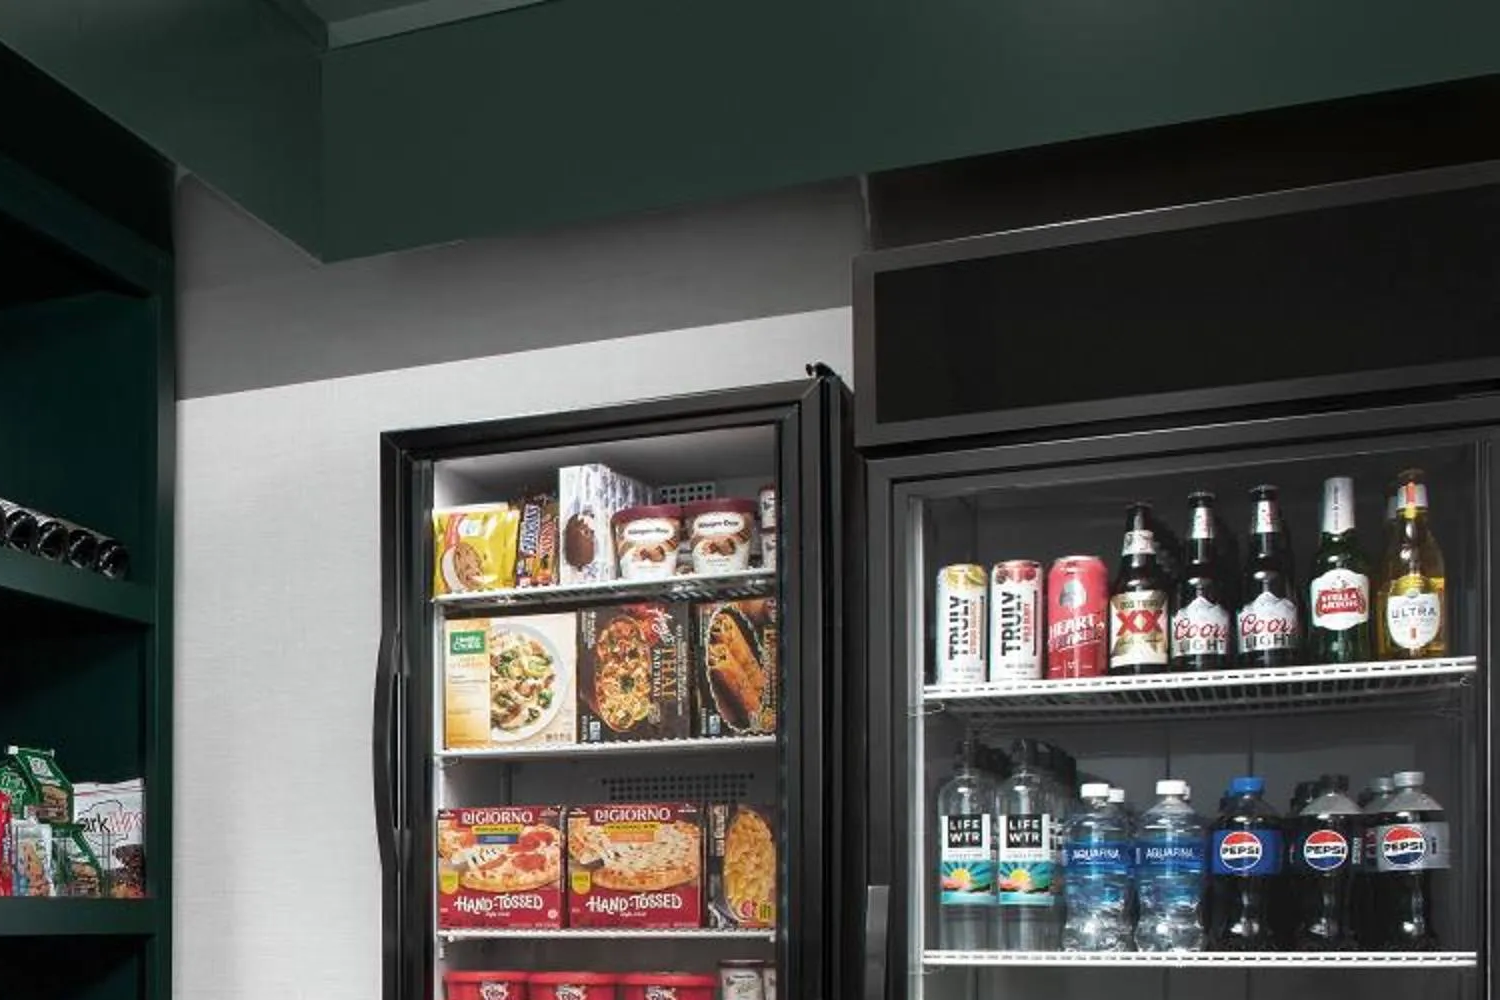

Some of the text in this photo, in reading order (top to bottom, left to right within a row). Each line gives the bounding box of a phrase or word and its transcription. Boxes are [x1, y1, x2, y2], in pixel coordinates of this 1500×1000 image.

[1391, 607, 1436, 619] ULTRA
[1001, 591, 1021, 656] TRULY
[661, 647, 677, 697] THAI
[949, 819, 980, 831] LIFE
[1008, 819, 1040, 831] LIFE
[949, 831, 980, 843] WTR
[1008, 831, 1042, 843] WTR
[1221, 845, 1260, 856] PEPSI
[1305, 844, 1345, 855] PEPSI
[1382, 841, 1424, 852] PEPSI
[1071, 848, 1120, 861] AQUAFINA
[1145, 847, 1195, 860] AQUAFINA
[453, 893, 544, 915] HAND-TOSSED
[585, 892, 683, 915] HAND-TOSSED
